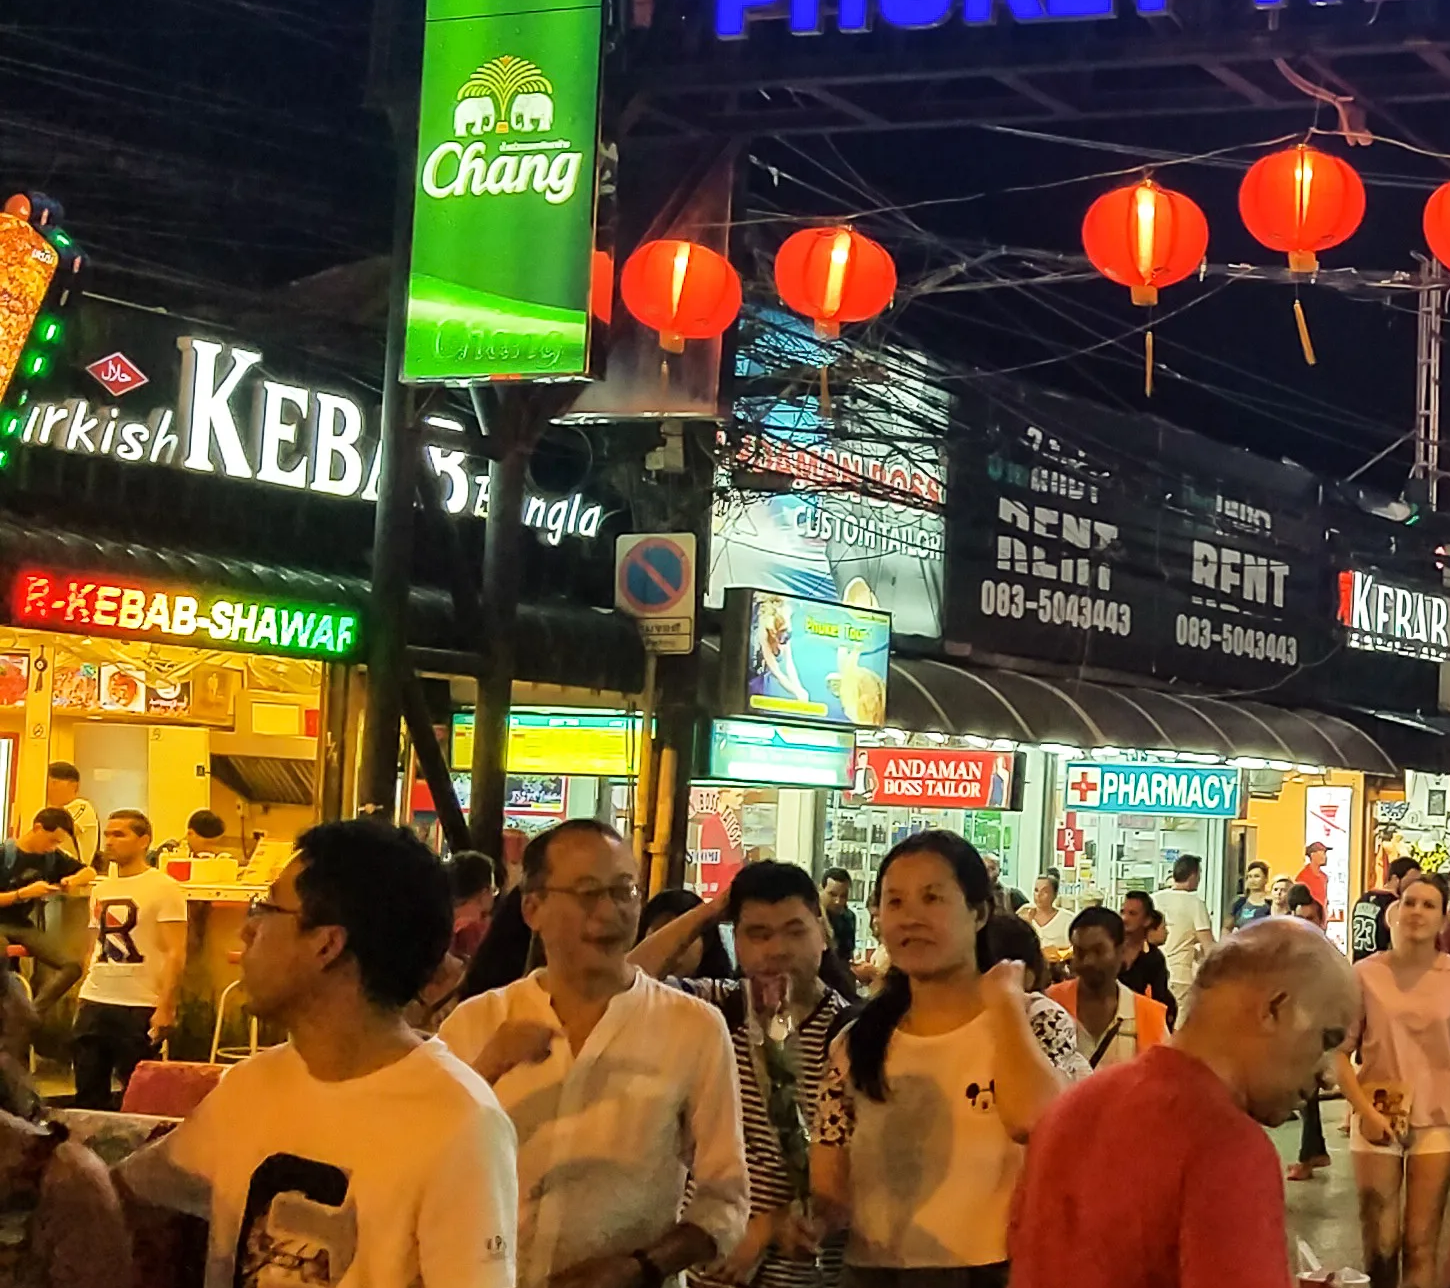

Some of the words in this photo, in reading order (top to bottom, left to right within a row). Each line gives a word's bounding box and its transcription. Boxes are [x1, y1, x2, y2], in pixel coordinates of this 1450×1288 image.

[421, 141, 583, 204] Chang
[793, 506, 876, 549] CUSTOM
[880, 521, 942, 561] TAILOR
[980, 579, 1132, 637] 083-5043443
[1175, 613, 1297, 666] 083-5043443
[883, 758, 984, 781] ANDAMAN
[883, 779, 923, 796] BOSS
[926, 780, 982, 799] TAILOR
[1102, 772, 1237, 811] PHARMACY
[97, 898, 145, 964] R
[1353, 916, 1378, 952] 23
